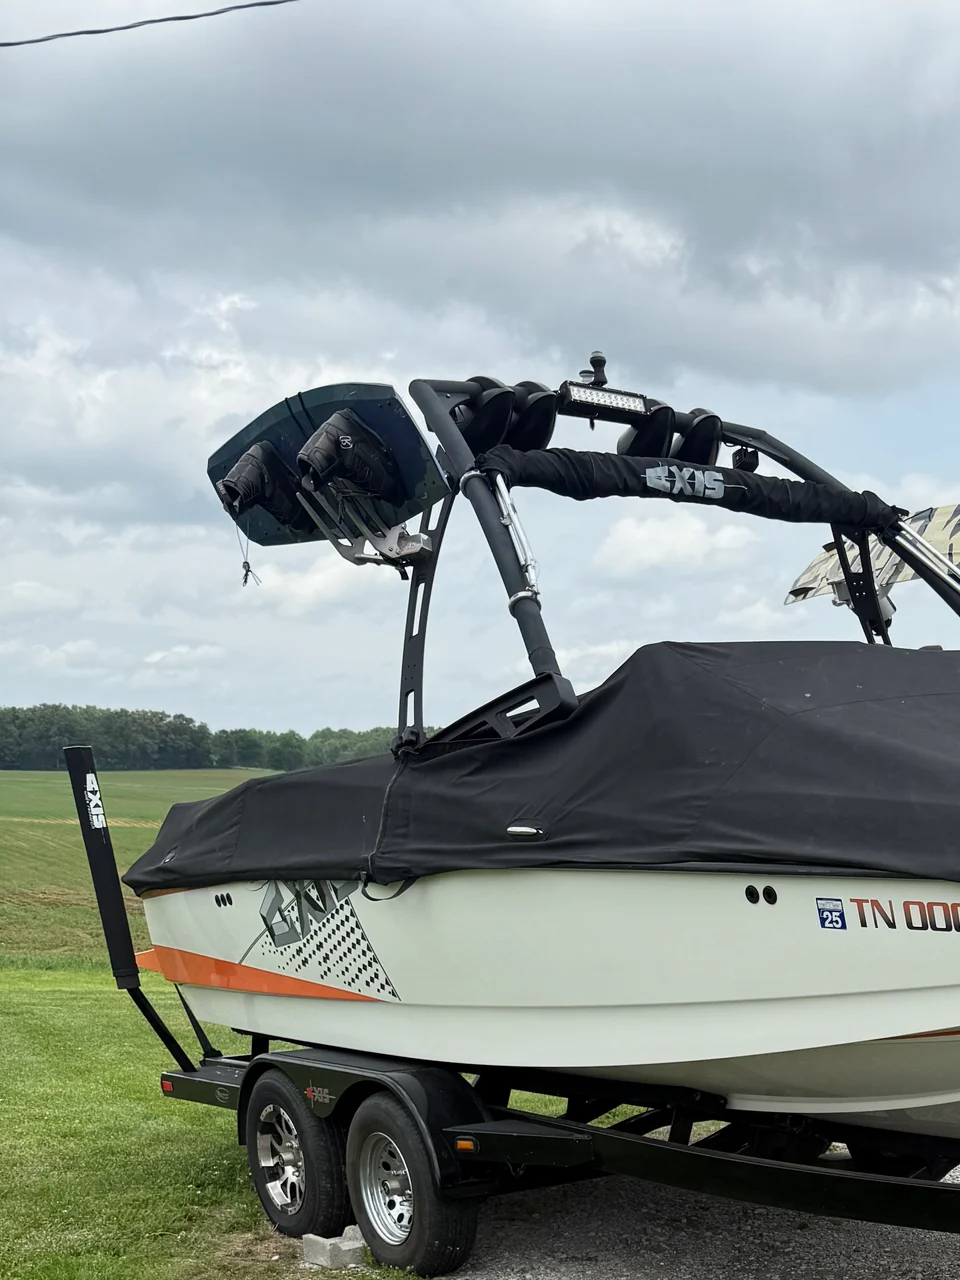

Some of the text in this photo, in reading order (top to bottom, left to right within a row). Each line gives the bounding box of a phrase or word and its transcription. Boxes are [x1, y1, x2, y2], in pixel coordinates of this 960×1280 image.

[646, 465, 724, 499] AXIS
[85, 773, 107, 829] AXIS
[823, 911, 843, 929] 25
[849, 898, 897, 930] TN
